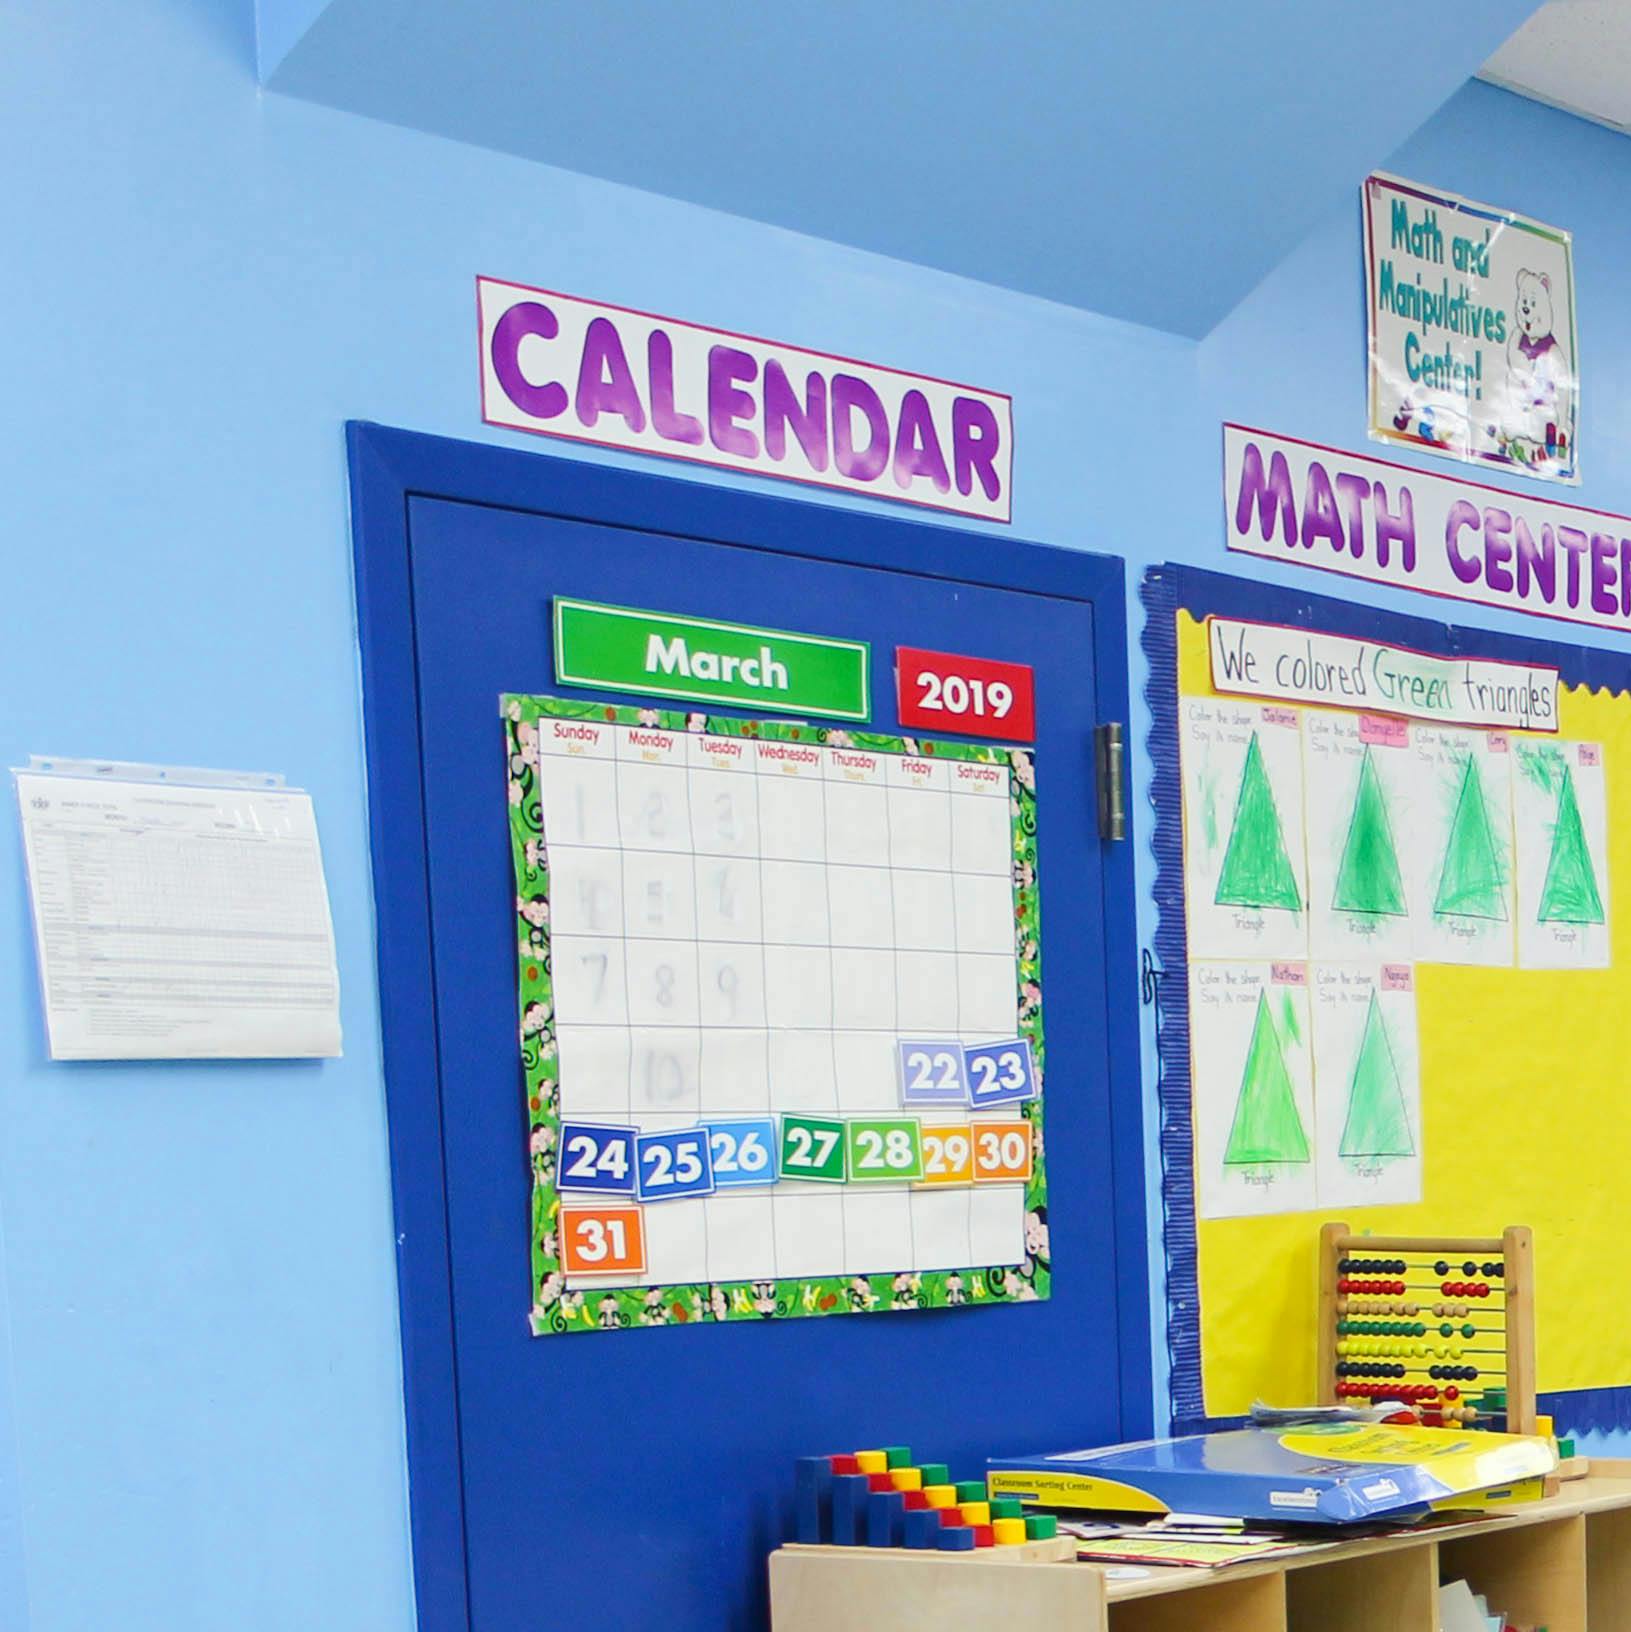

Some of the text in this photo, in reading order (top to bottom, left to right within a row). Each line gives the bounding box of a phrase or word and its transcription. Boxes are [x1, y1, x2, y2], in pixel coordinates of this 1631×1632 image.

[1391, 199, 1490, 279] Math and
[1379, 258, 1507, 344] Manipulatives
[1403, 331, 1482, 401] Center!
[491, 302, 1000, 502] CALENDAR
[1236, 443, 1416, 573] MATH
[645, 634, 790, 690] March
[1215, 625, 1553, 729] We colored Green triangles
[916, 673, 1013, 719] 2019
[554, 723, 599, 745] Sunday
[629, 731, 674, 752] Monday
[699, 737, 742, 759] Tuesday
[757, 743, 819, 767] Wednesday
[832, 751, 876, 773] Thursday
[902, 759, 932, 778] Friday
[958, 765, 1000, 785] Saturday
[906, 1052, 961, 1090] 22
[970, 1051, 1027, 1094] 23
[566, 1135, 629, 1180] 24
[643, 1141, 703, 1187] 25
[710, 1131, 769, 1171] 26
[785, 1127, 838, 1169] 27
[855, 1130, 914, 1169] 28
[922, 1134, 969, 1174] 29
[978, 1132, 1026, 1171] 30
[575, 1219, 627, 1261] 31
[1034, 1479, 1064, 1490] Sorting
[1065, 1481, 1094, 1492] Center
